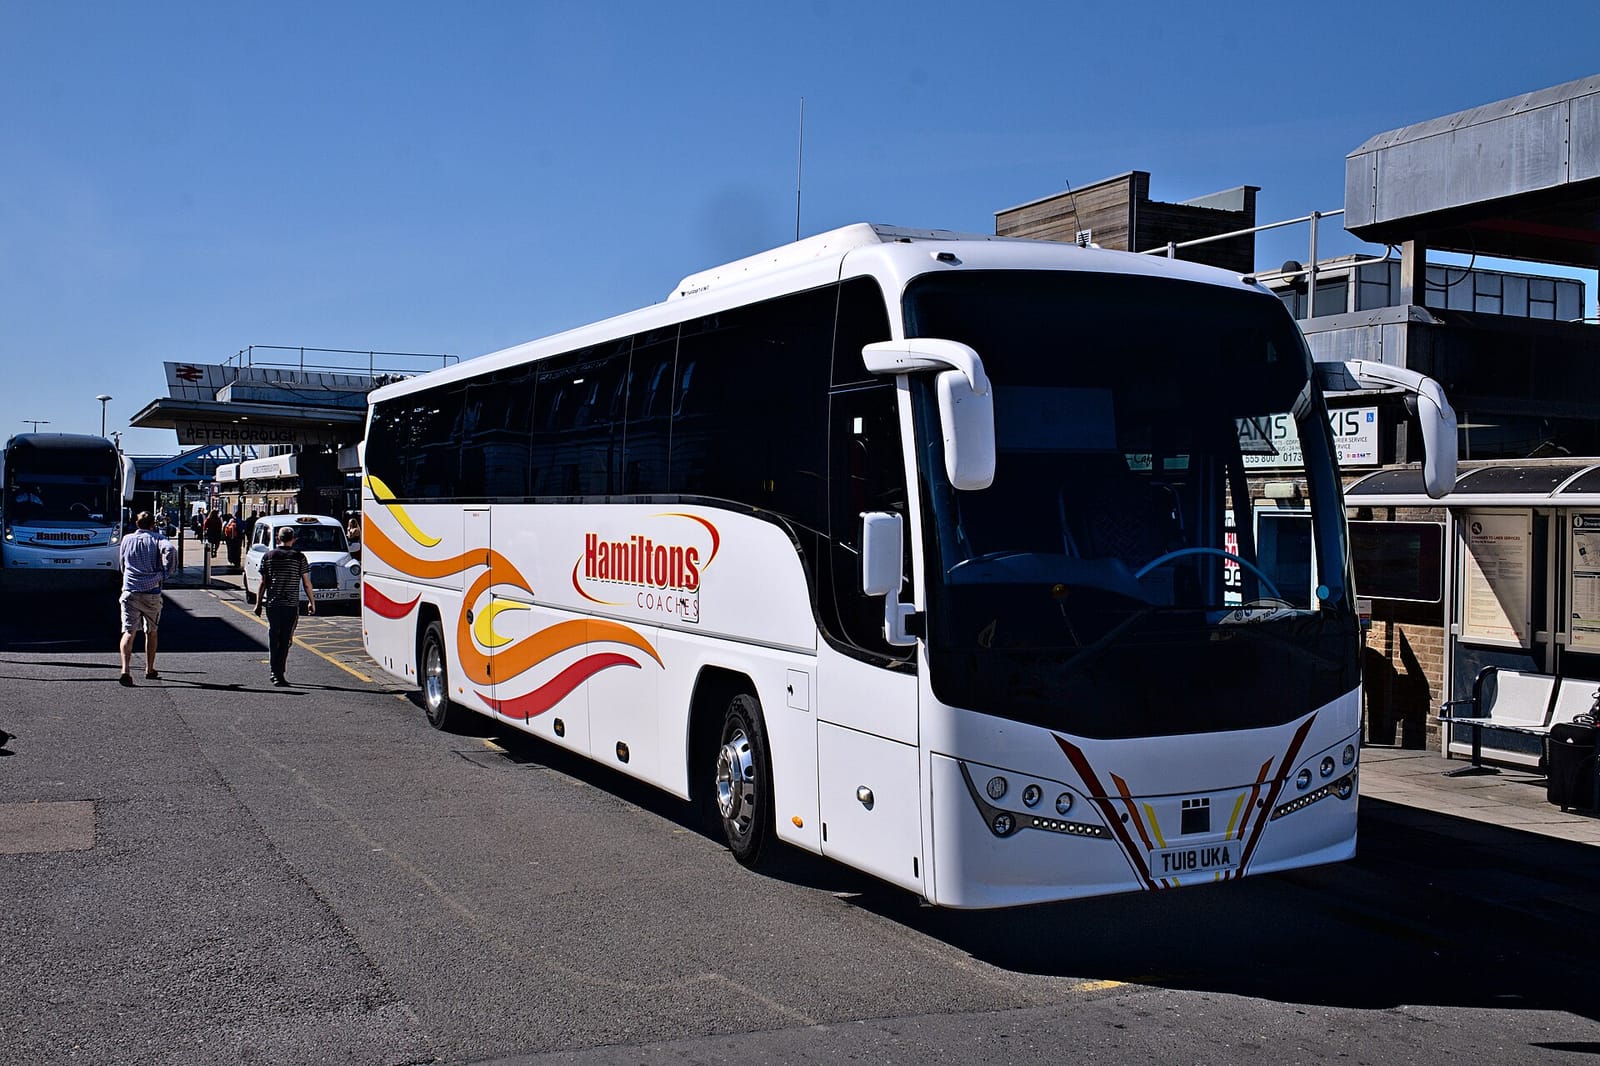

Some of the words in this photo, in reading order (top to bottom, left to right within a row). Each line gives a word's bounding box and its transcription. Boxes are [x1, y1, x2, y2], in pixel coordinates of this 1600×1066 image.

[186, 428, 296, 442] PETERBOROUGH
[1329, 411, 1359, 436] XIS
[36, 532, 91, 540] Hamiltons
[585, 532, 700, 591] Hamiltons
[637, 592, 699, 617] COACHES
[1161, 851, 1197, 872] TU18
[1201, 846, 1230, 867] UKA
